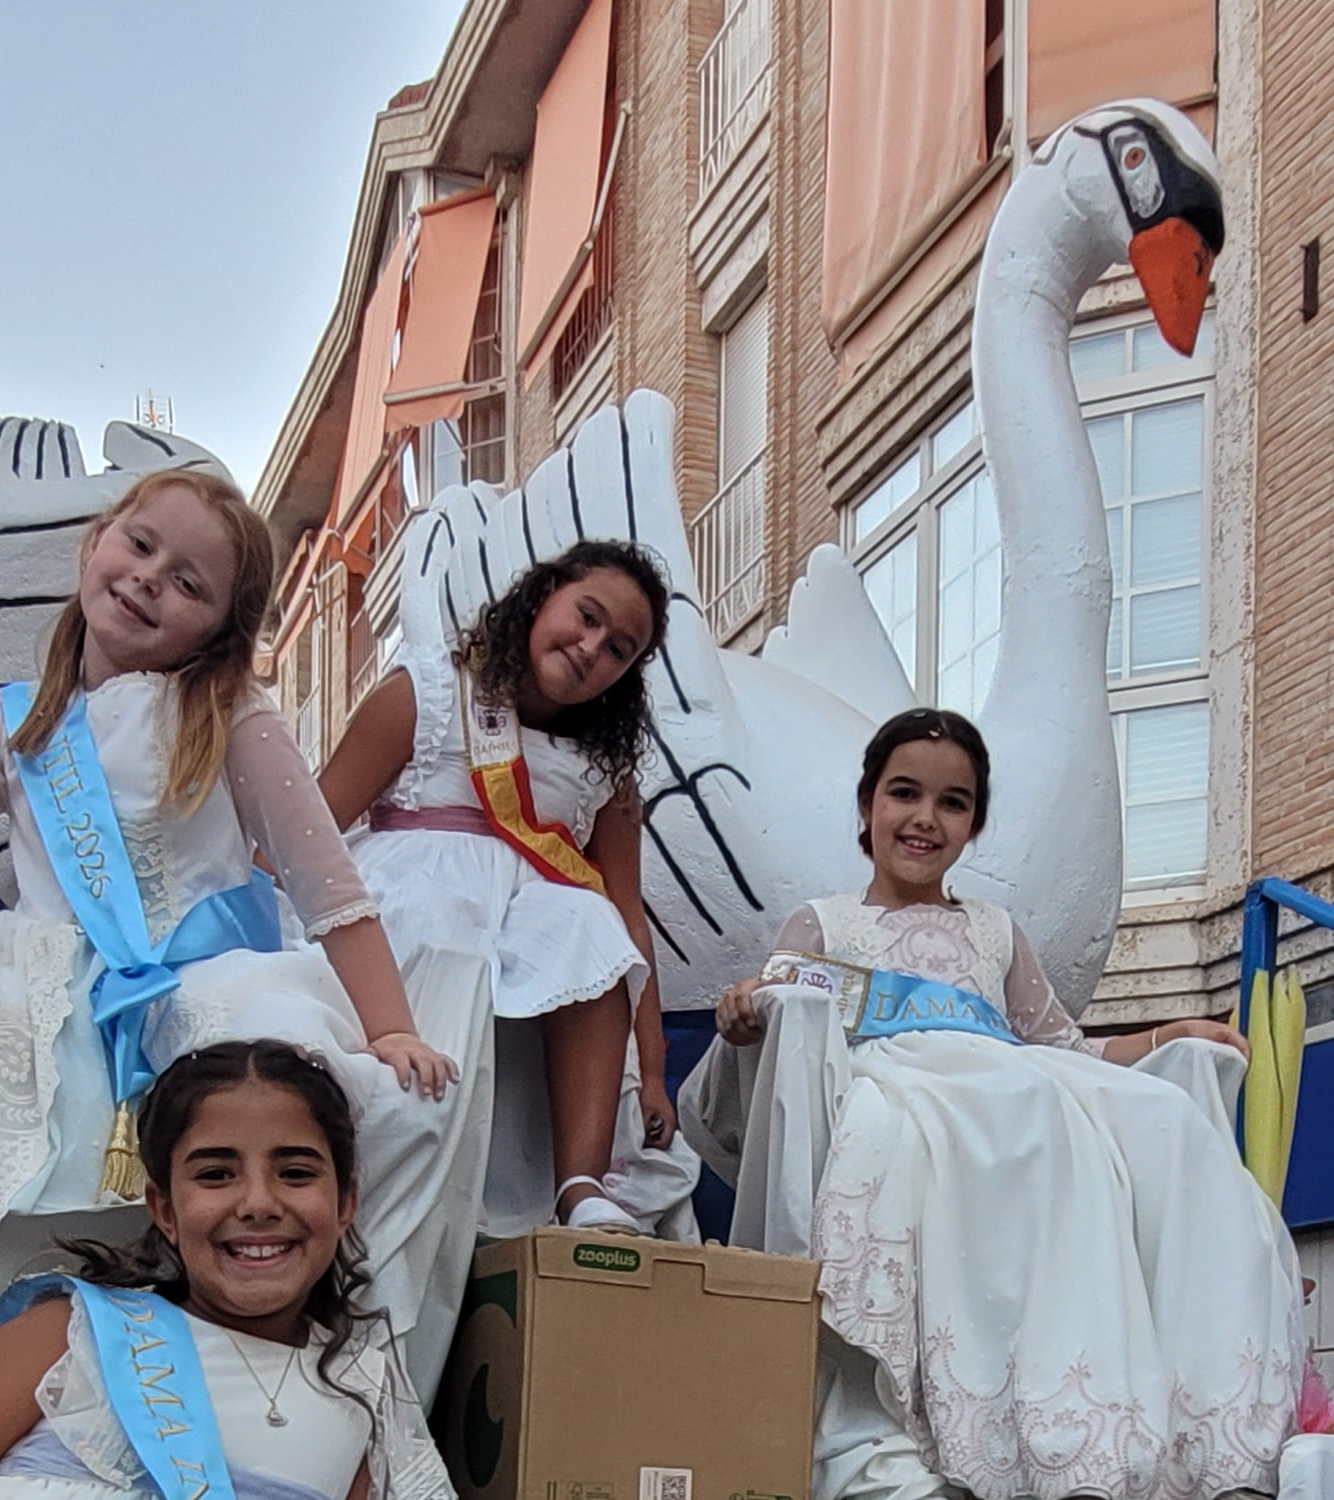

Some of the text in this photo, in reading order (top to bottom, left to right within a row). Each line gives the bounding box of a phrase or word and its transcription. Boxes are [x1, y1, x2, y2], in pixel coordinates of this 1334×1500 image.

[67, 812, 112, 899] 2026
[873, 992, 982, 1023] DAMA
[578, 1249, 637, 1267] zooplus
[108, 1294, 192, 1442] DAMA
